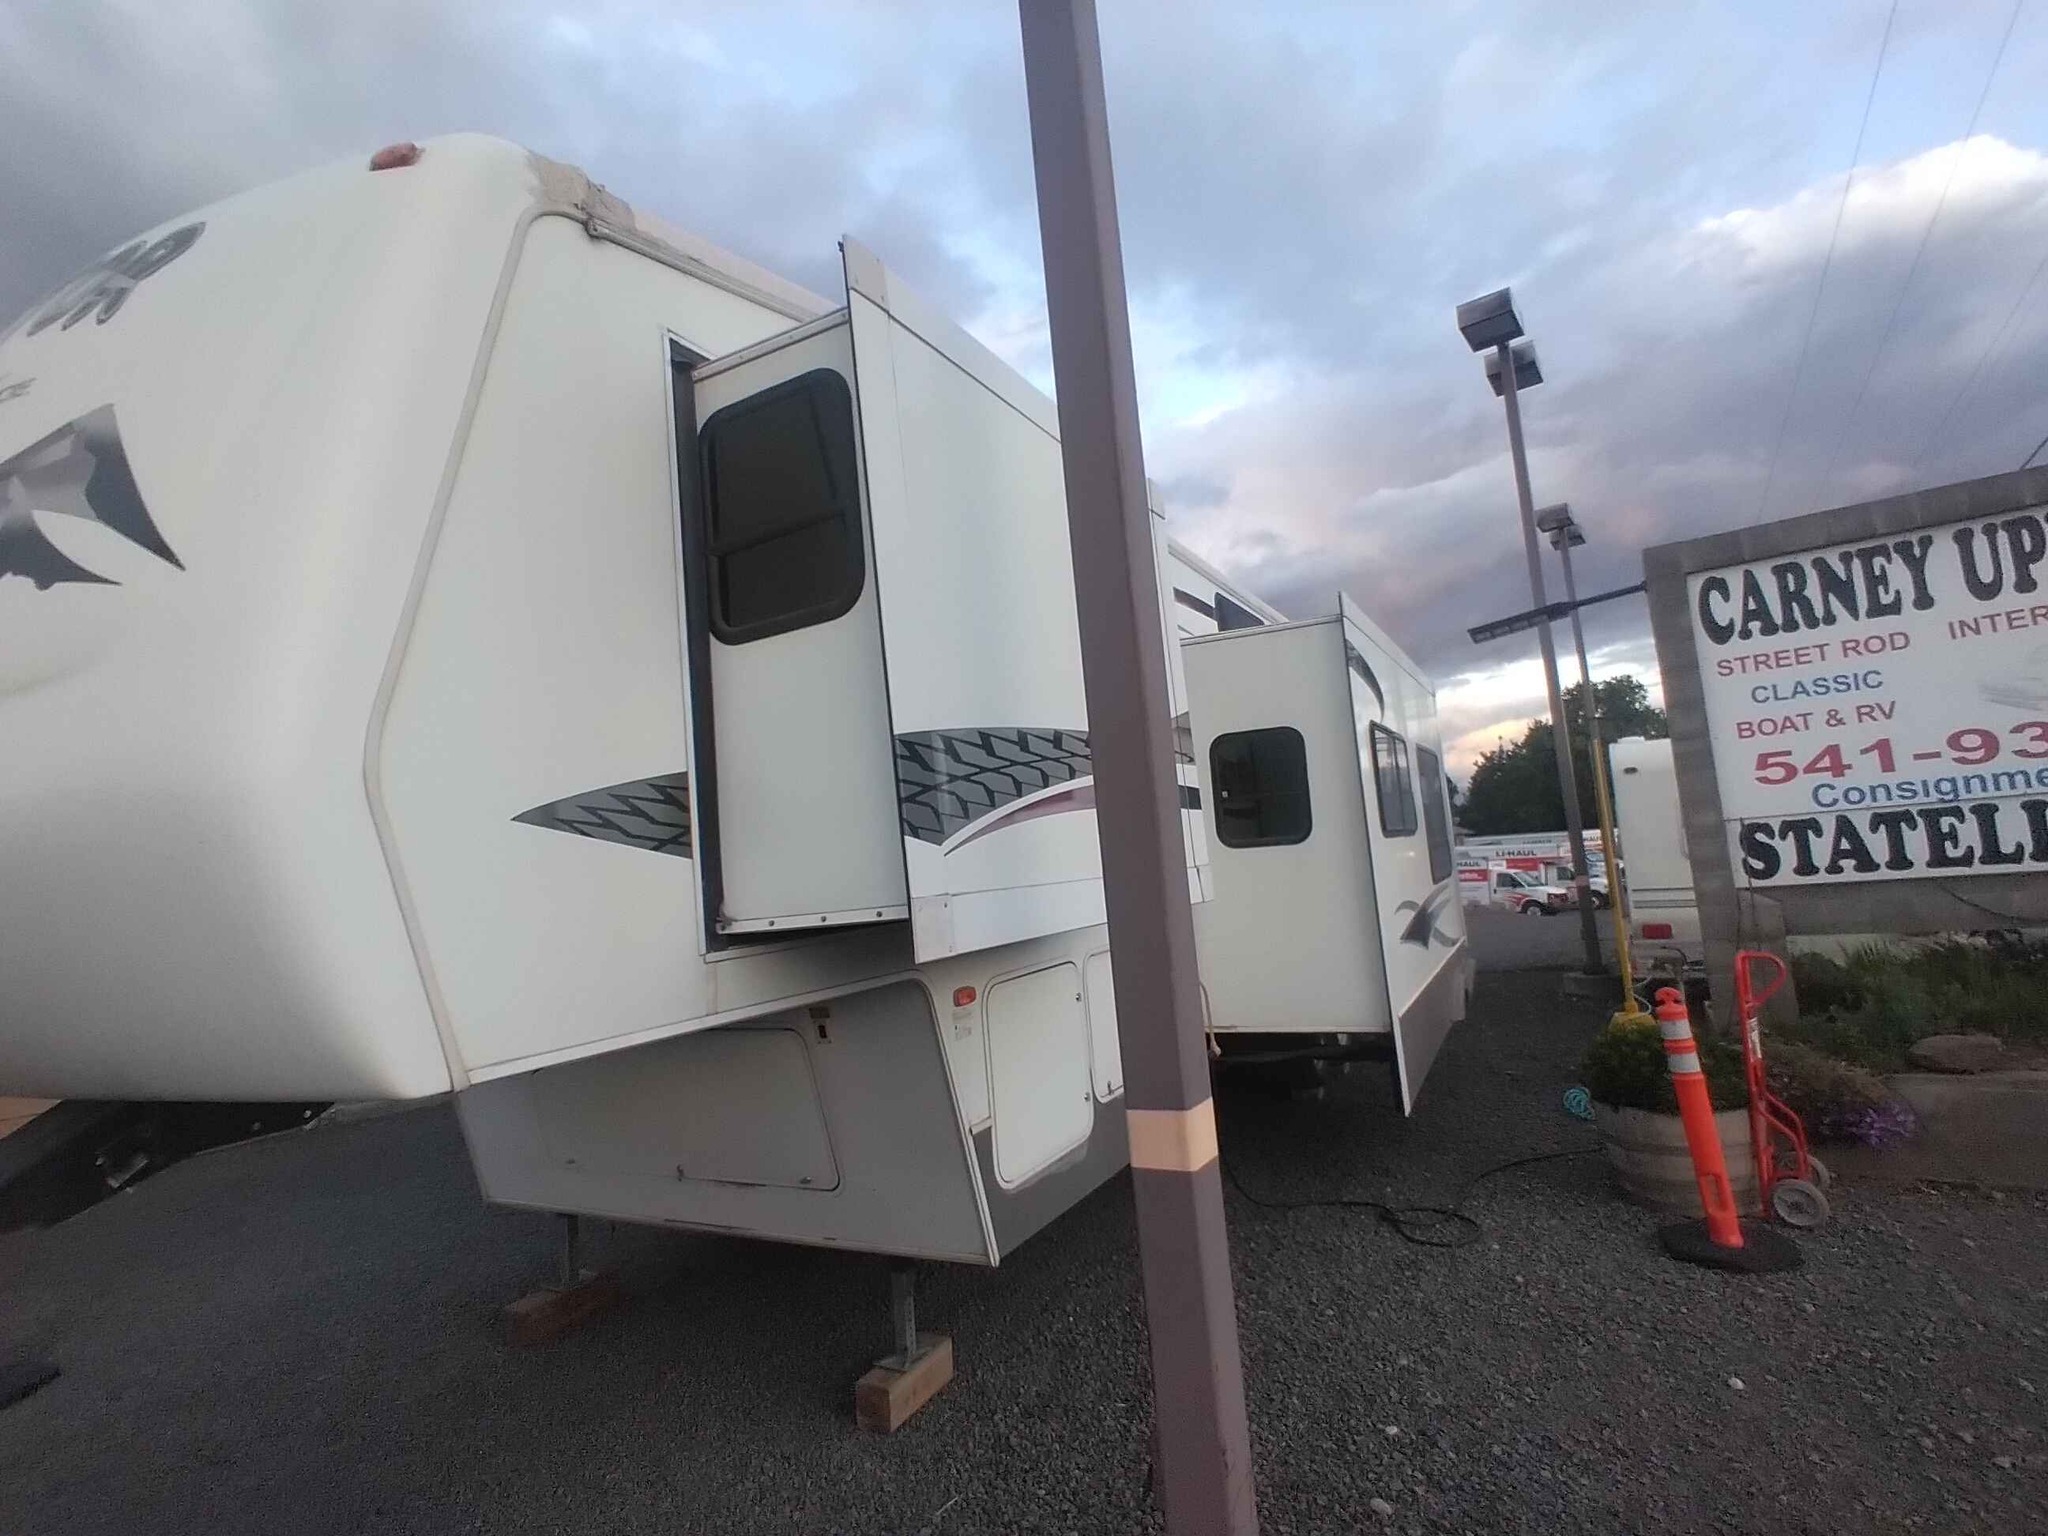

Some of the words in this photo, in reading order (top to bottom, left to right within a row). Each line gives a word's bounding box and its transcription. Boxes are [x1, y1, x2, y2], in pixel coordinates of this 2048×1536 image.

[1698, 534, 1935, 646] CARNEY
[1951, 512, 2048, 602] UP
[1716, 643, 1830, 678] STREET
[1841, 631, 1911, 658] ROD
[1751, 669, 1884, 704] CLASSIC
[1736, 711, 1814, 740] BOAT
[1824, 708, 1847, 728] &
[1855, 700, 1896, 724] RV
